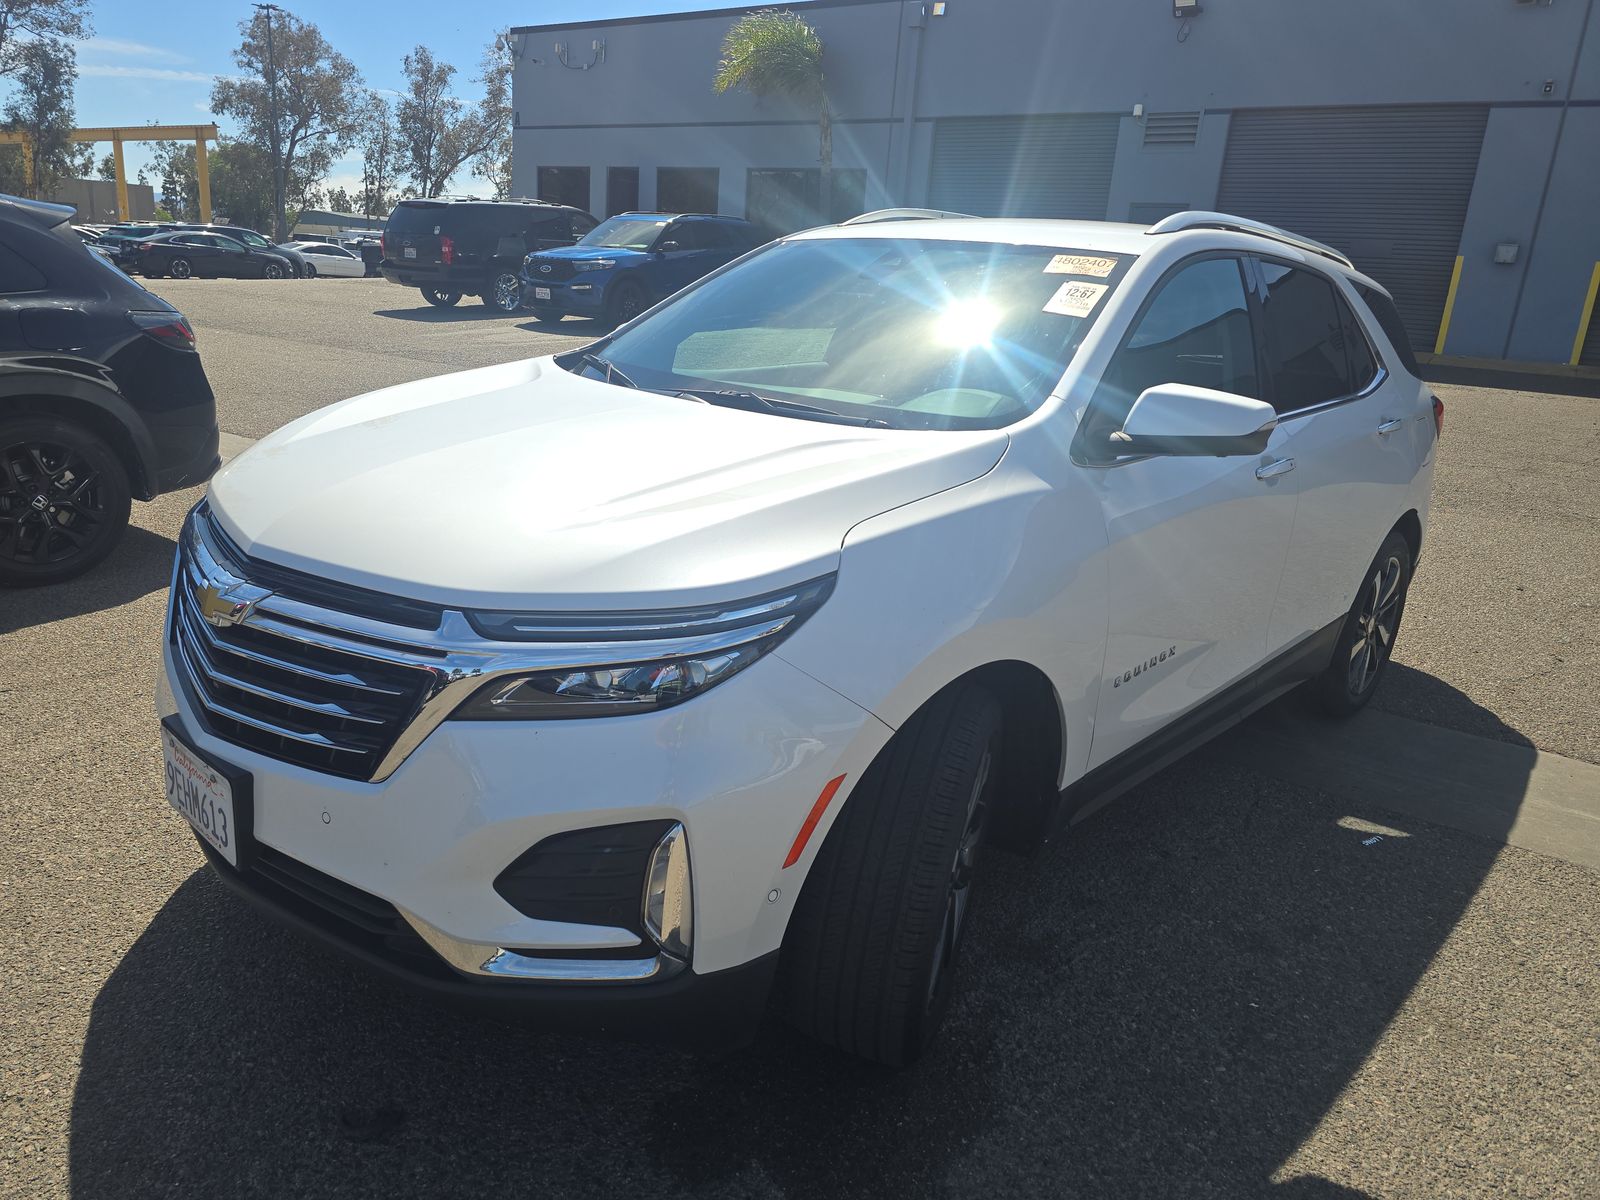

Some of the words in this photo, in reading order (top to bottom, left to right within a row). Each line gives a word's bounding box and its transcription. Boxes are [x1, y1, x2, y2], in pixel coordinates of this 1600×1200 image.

[1066, 287, 1096, 299] 12:67
[1113, 645, 1176, 689] EQUINOX
[173, 746, 216, 793] California
[166, 760, 229, 848] 9EHM613
